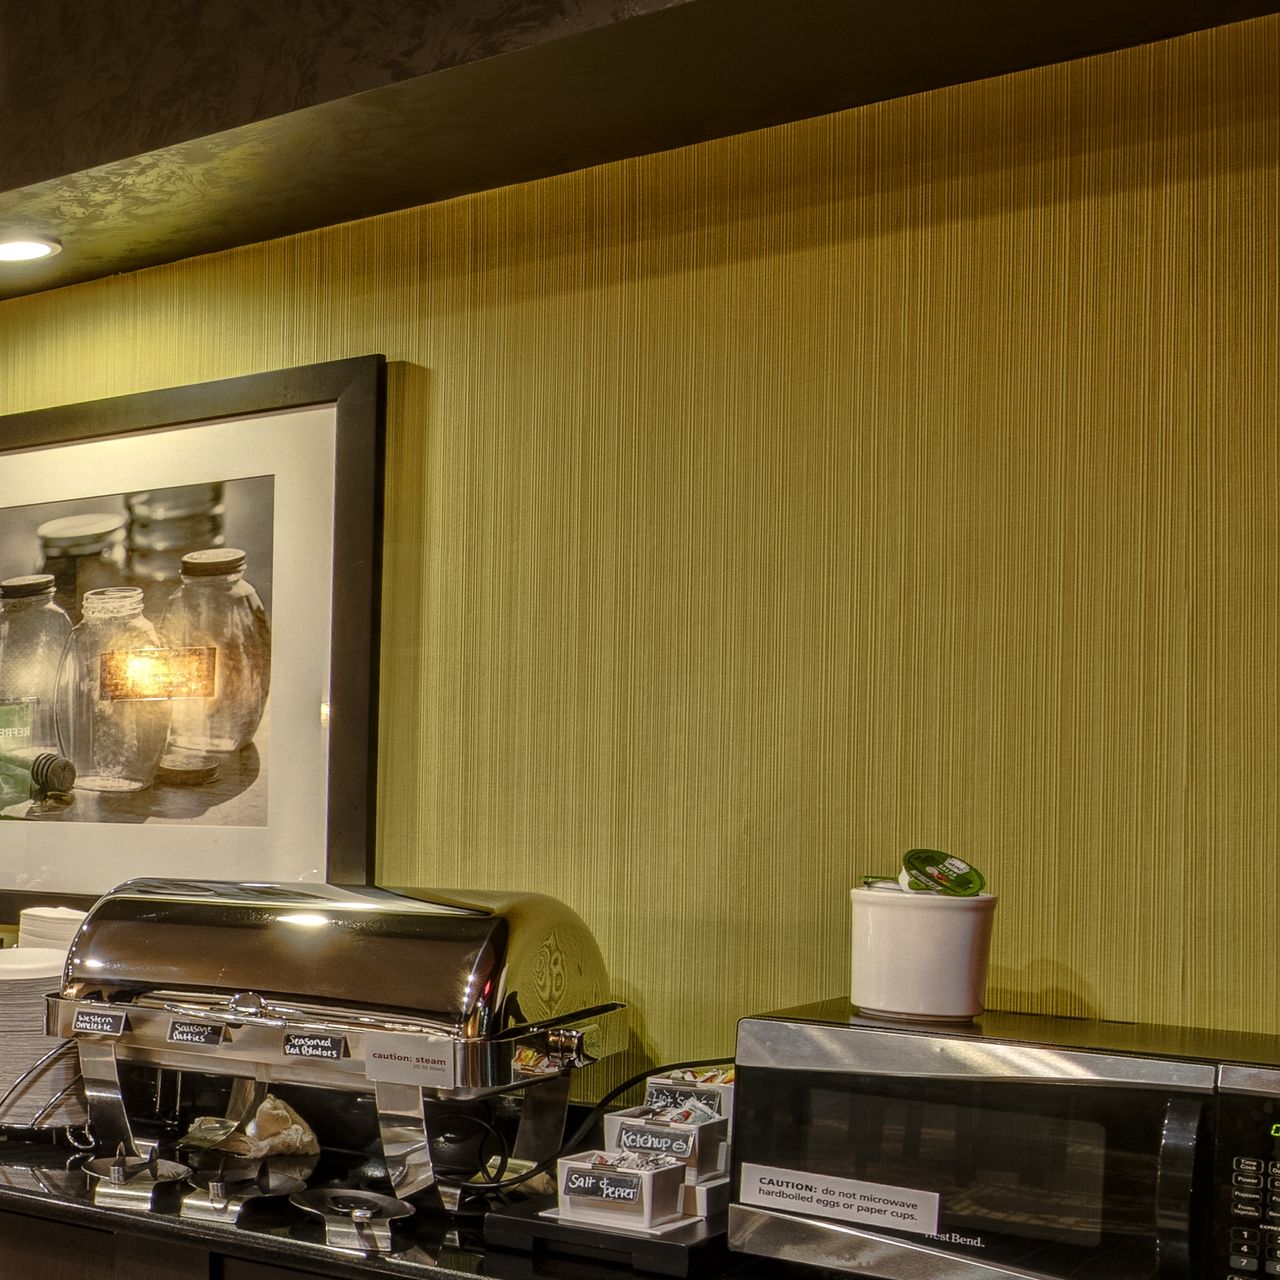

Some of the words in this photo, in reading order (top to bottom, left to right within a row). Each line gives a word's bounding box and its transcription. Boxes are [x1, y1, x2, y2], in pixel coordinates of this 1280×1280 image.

[78, 1014, 113, 1023] Western
[175, 1022, 212, 1035] Sausage
[173, 1032, 206, 1043] Patties
[289, 1035, 332, 1047] Seasoned
[284, 1045, 300, 1055] Red
[301, 1045, 338, 1058] Potatoes
[372, 1051, 413, 1063] caution:
[415, 1056, 447, 1066] steam
[621, 1130, 671, 1151] Ketchup
[568, 1174, 596, 1188] Salt
[758, 1177, 818, 1194] CAUTION:
[821, 1186, 836, 1197] do
[838, 1191, 857, 1200] not
[859, 1193, 918, 1210] microwave
[758, 1187, 814, 1204] hardboiled
[816, 1197, 840, 1209] eggs
[842, 1202, 855, 1210] or
[856, 1204, 889, 1216] paper
[890, 1210, 918, 1221] cups.
[924, 1233, 951, 1242] est
[1242, 1231, 1248, 1239] 1
[1240, 1245, 1248, 1253] 4
[1240, 1258, 1248, 1266] 7
